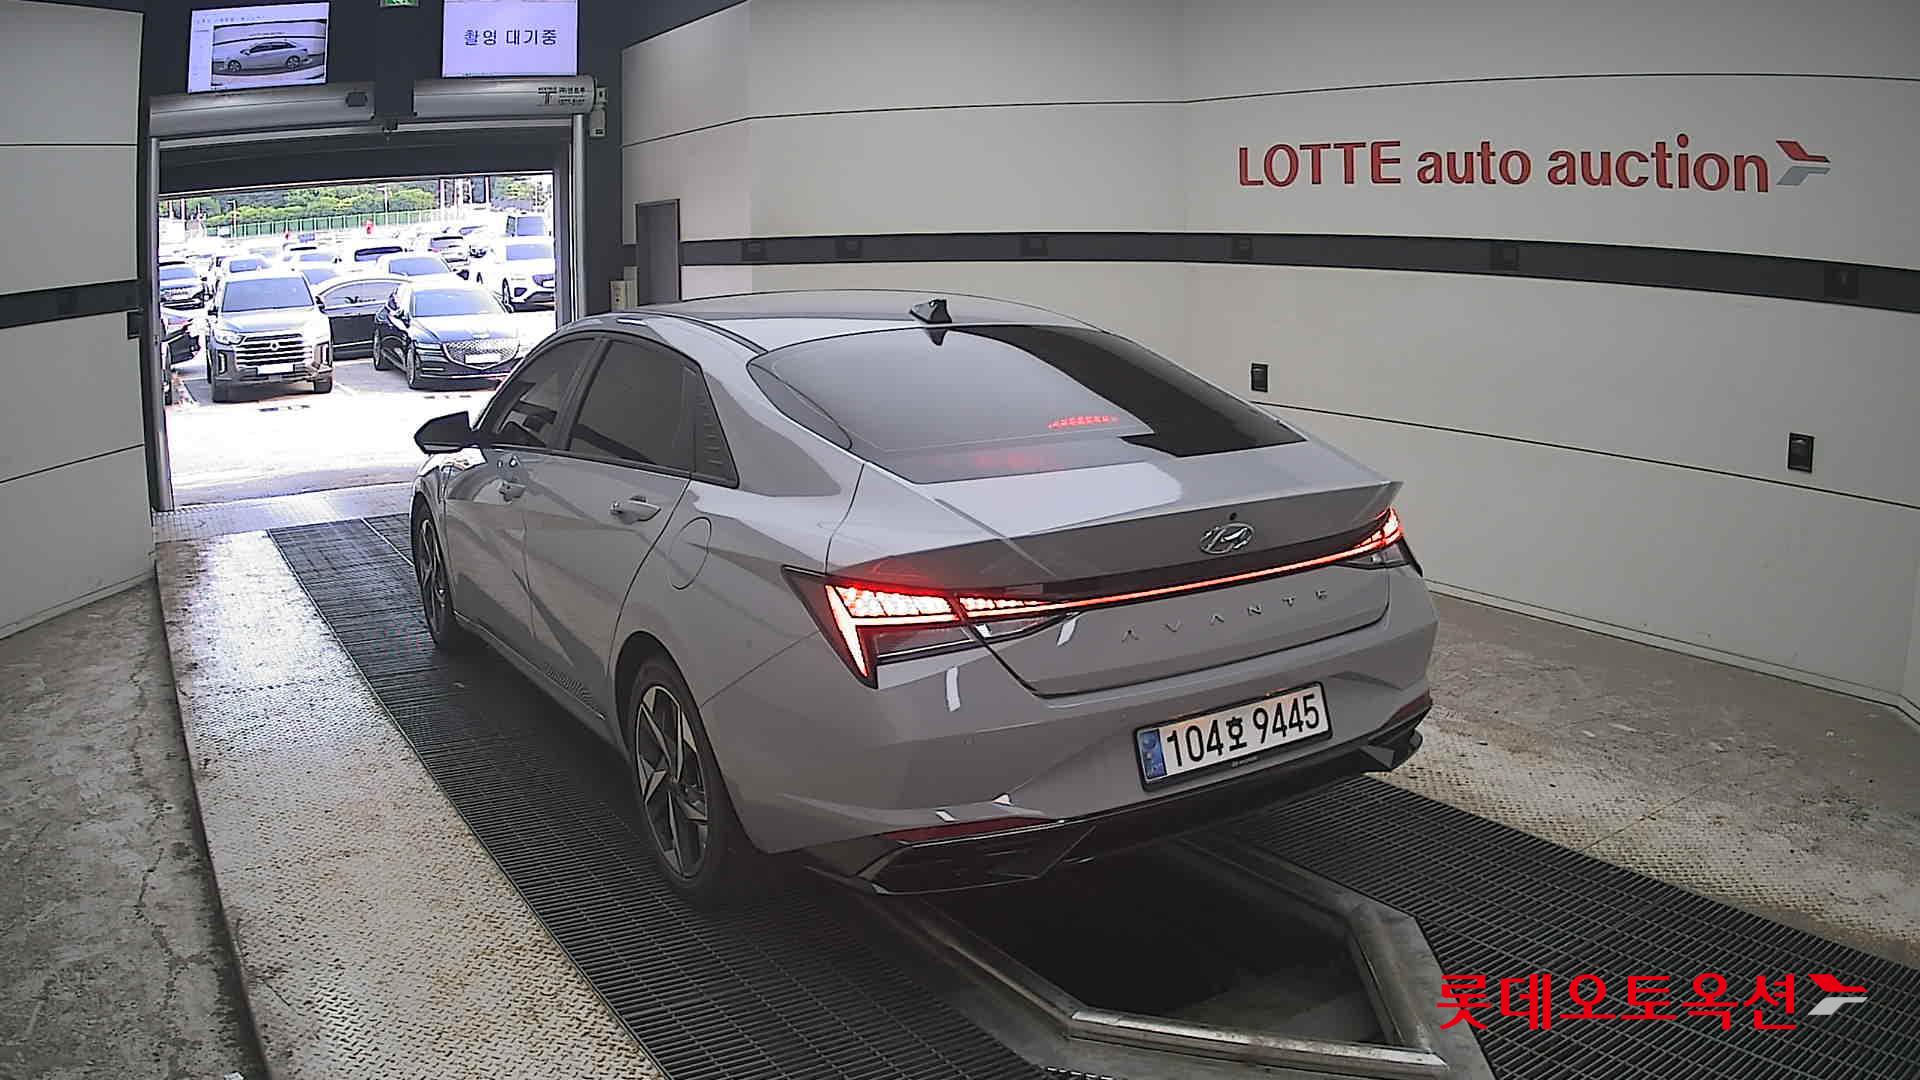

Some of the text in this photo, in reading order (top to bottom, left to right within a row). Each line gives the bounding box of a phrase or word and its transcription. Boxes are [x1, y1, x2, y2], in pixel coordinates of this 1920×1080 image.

[505, 29, 558, 46] 대기중
[1239, 133, 1770, 193] LOTTE auto auction
[1120, 589, 1329, 644] AVANTE
[1166, 693, 1320, 767] 104호 9445
